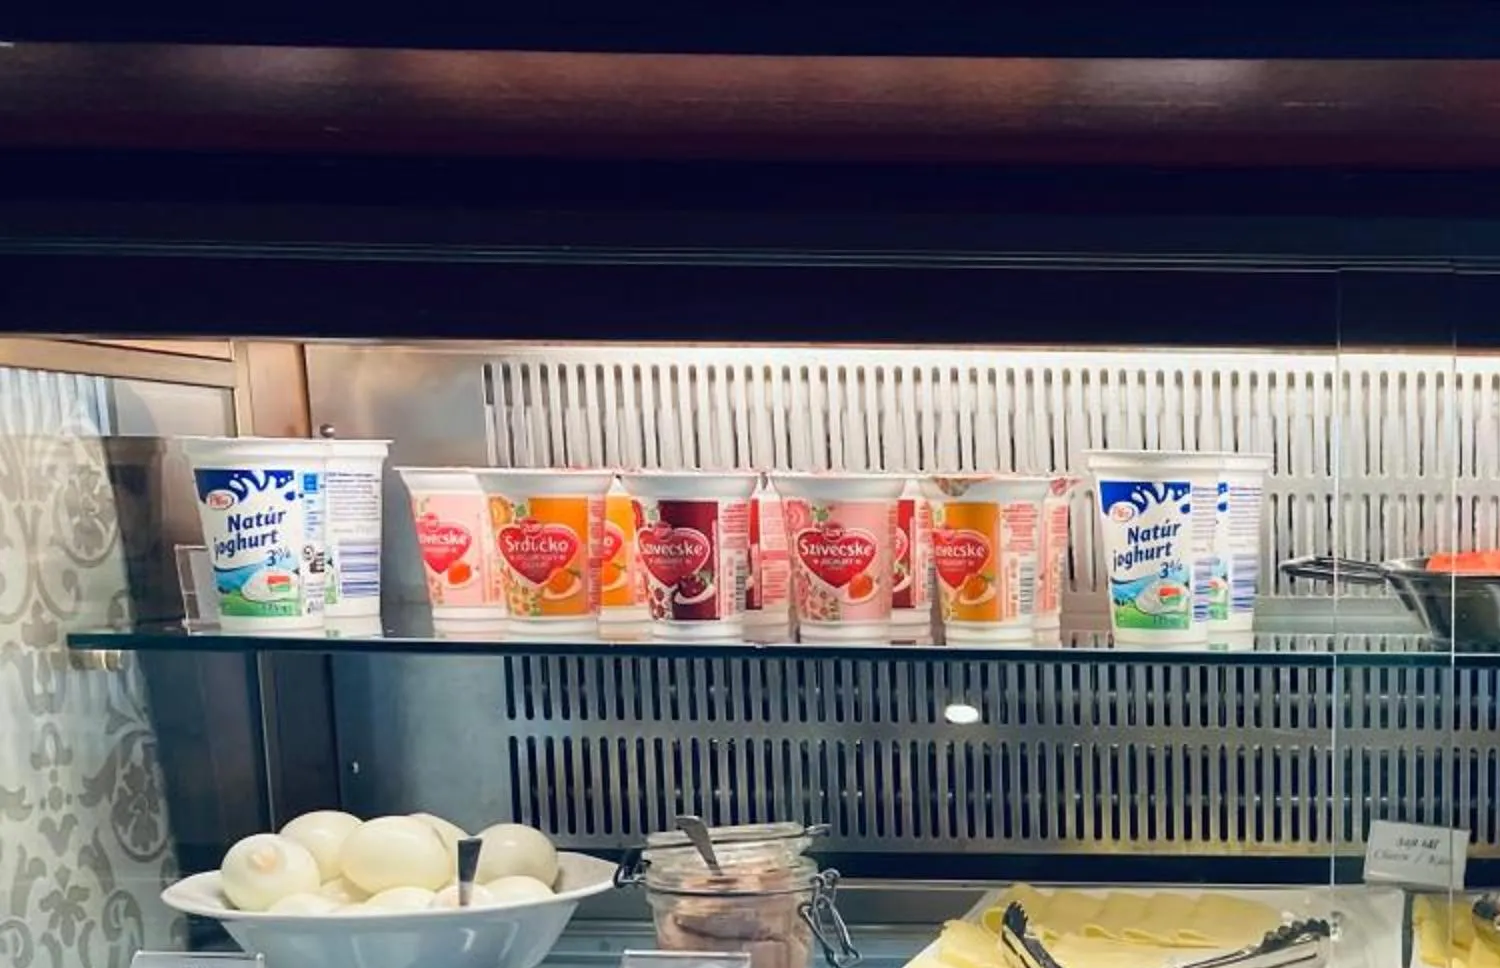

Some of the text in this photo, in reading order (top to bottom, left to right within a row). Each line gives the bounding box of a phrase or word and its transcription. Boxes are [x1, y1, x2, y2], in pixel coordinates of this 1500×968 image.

[227, 506, 286, 533] Natúr
[1127, 518, 1181, 545] Natúr
[214, 529, 279, 561] joghurt
[1113, 542, 1172, 572] joghurt
